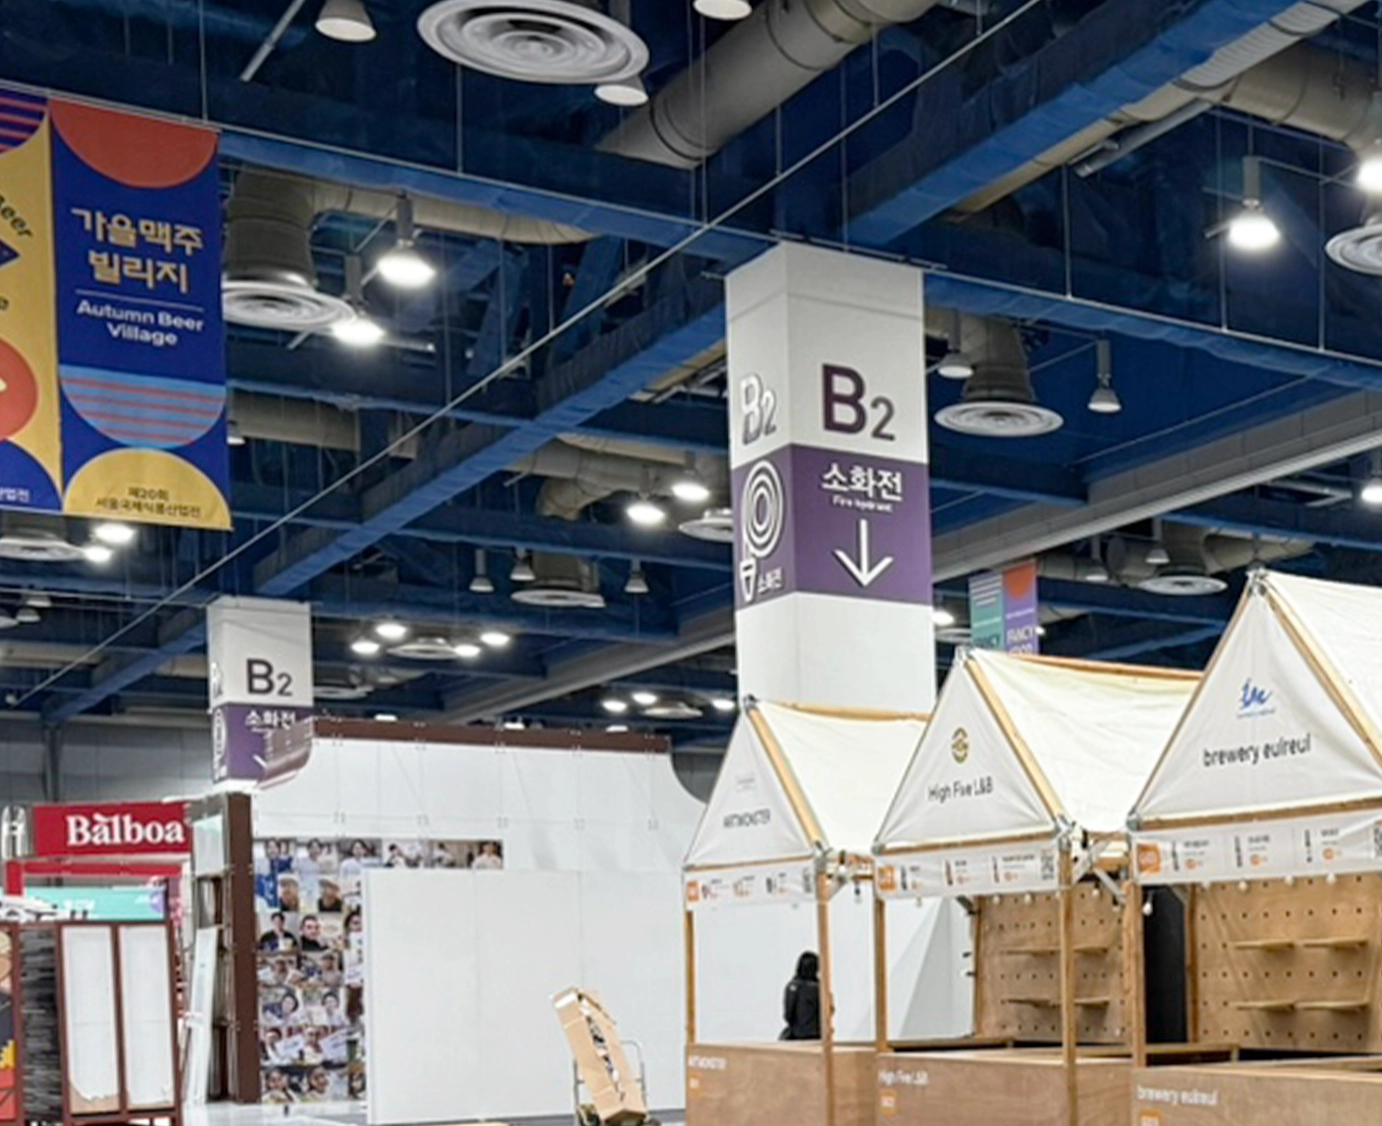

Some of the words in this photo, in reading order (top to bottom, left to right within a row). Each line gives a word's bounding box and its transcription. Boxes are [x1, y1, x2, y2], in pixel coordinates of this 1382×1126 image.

[71, 207, 203, 256] 가을맥주
[88, 250, 188, 293] 빌리지
[77, 299, 155, 324] Autumn
[157, 312, 204, 331] Beer
[107, 322, 178, 346] Village
[740, 374, 777, 445] B2
[822, 363, 895, 441] B2
[821, 463, 903, 502] 소화전
[247, 658, 293, 696] B2
[1203, 746, 1260, 768] brewery
[928, 783, 951, 805] High
[953, 780, 973, 798] Five
